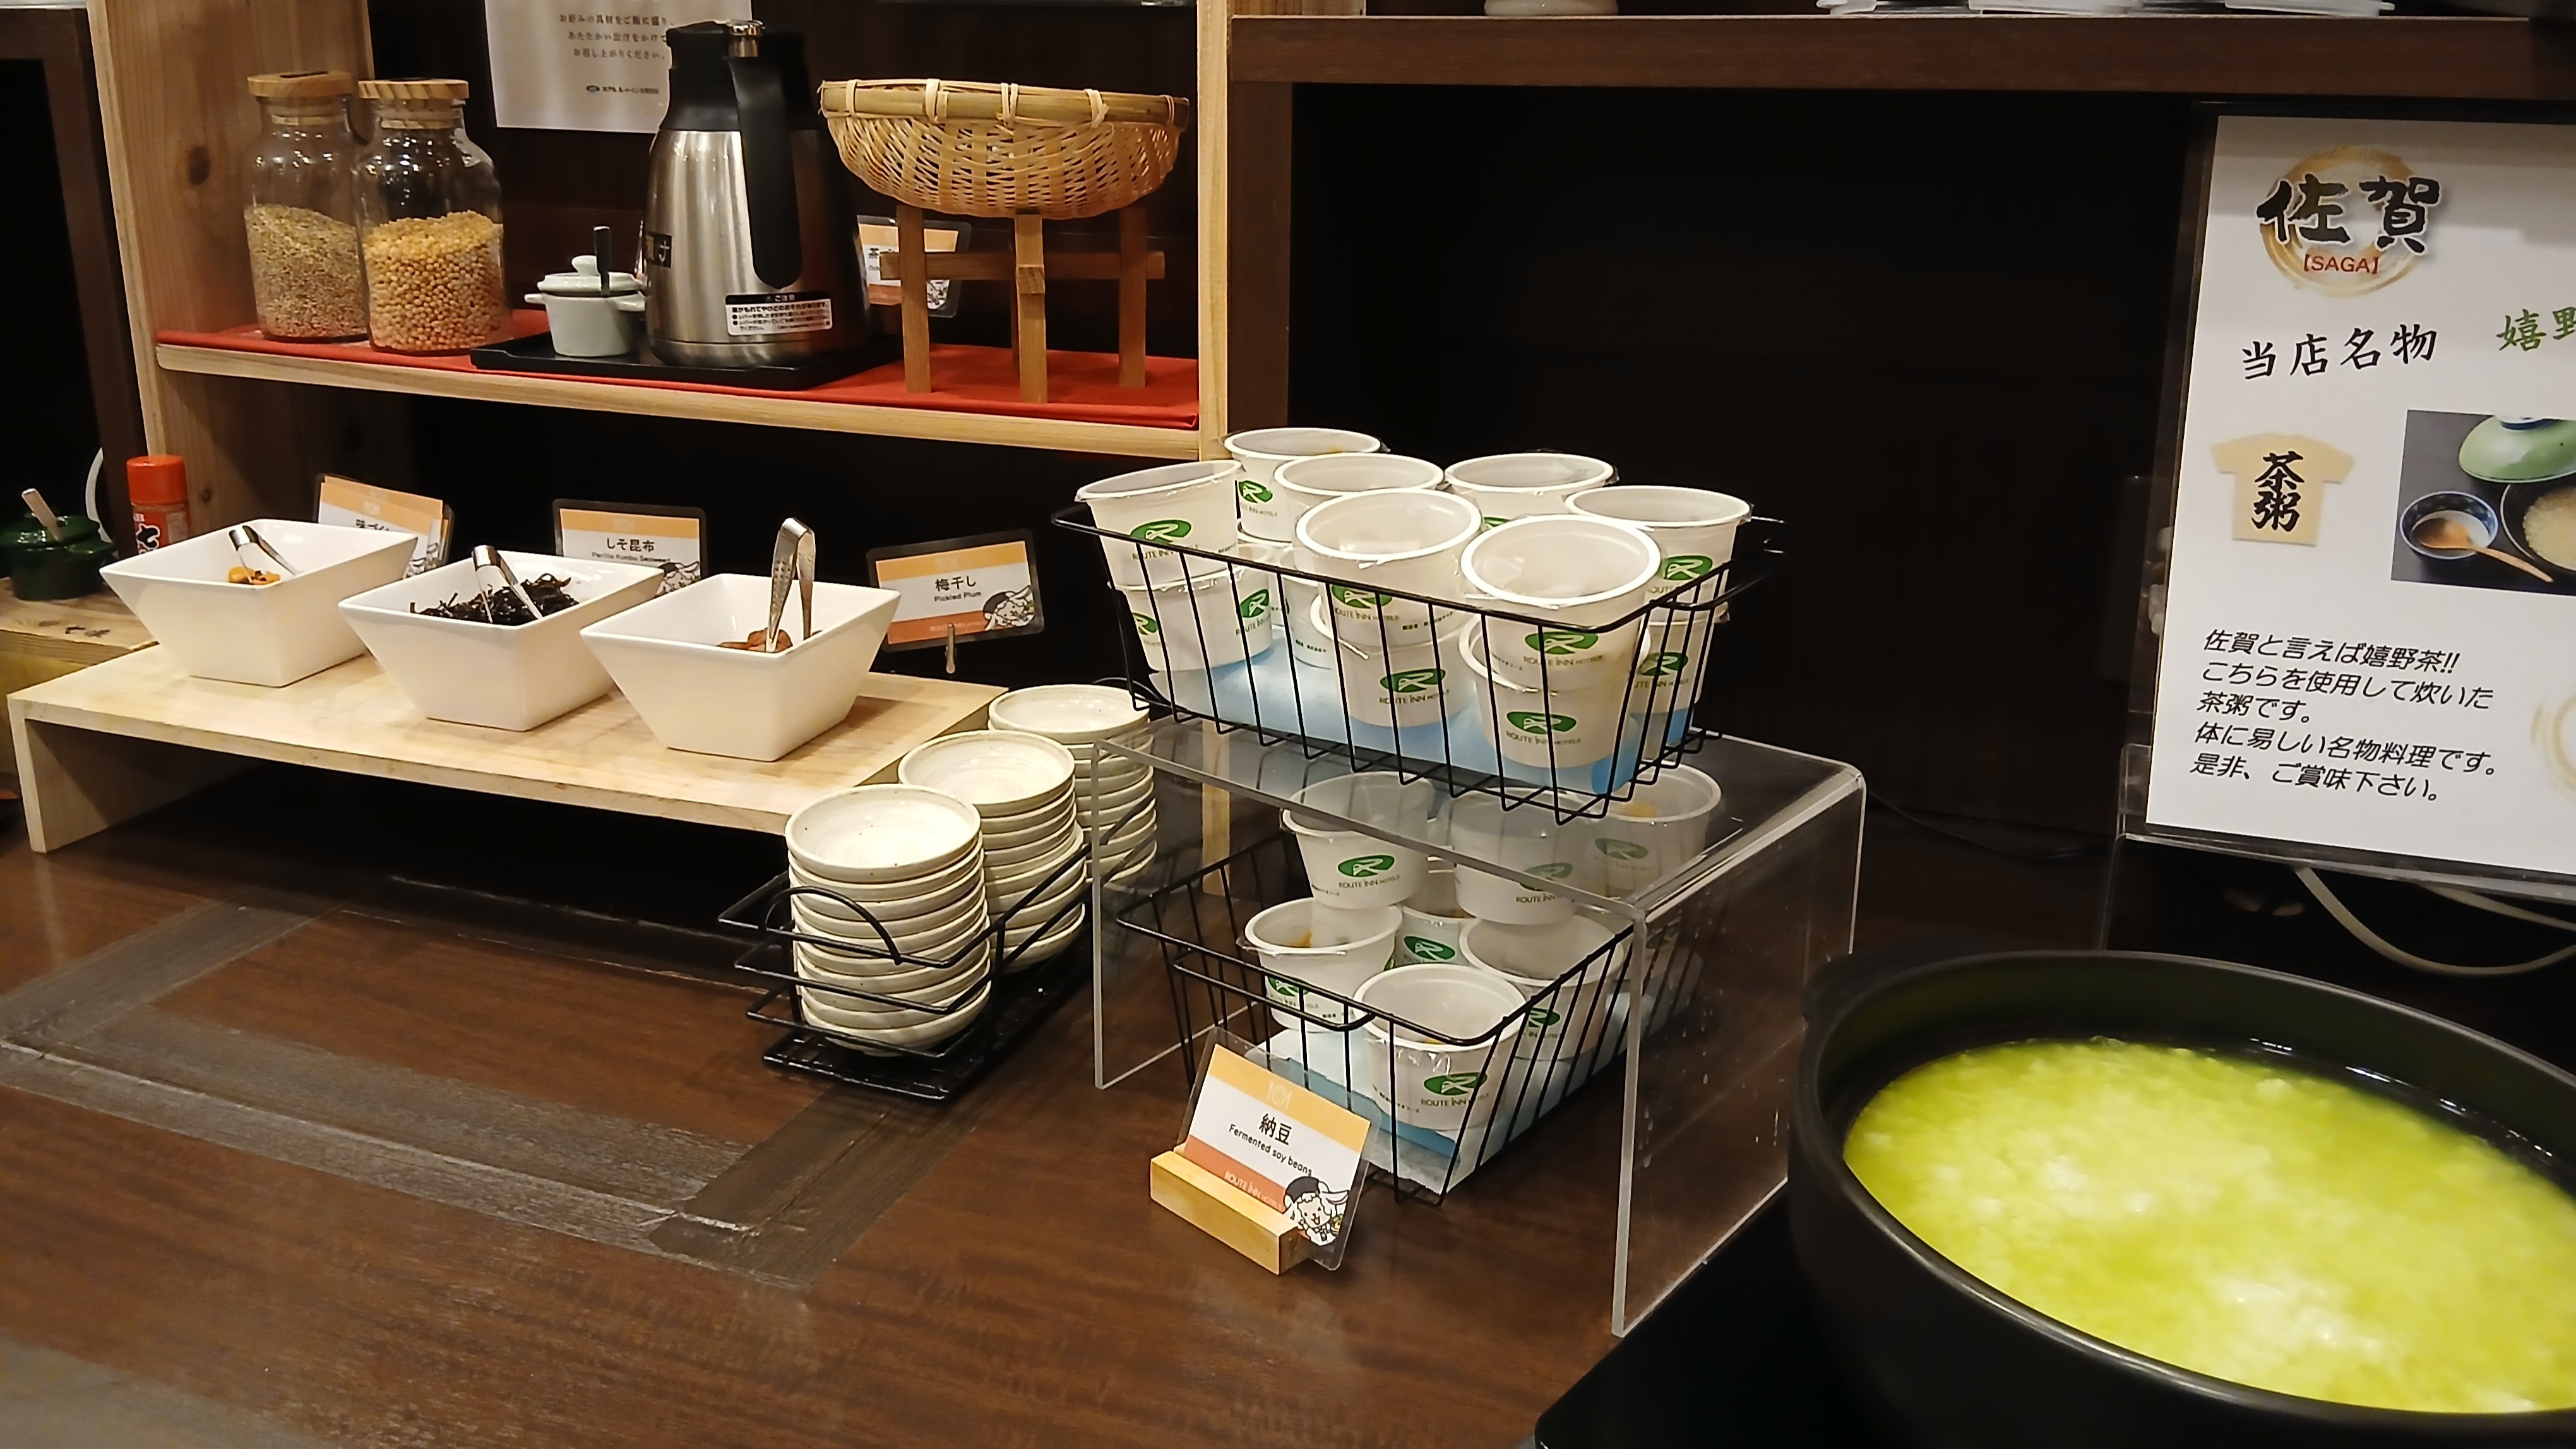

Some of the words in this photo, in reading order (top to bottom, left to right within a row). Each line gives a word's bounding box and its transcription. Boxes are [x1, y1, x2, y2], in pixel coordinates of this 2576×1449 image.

[2258, 174, 2440, 253] 佐賀
[2242, 325, 2437, 379] 当店名物
[2251, 451, 2305, 532] 茶粥
[607, 538, 655, 552] しそ昆布
[934, 593, 962, 602] Pickled
[935, 576, 977, 592] 梅干し
[2197, 691, 2310, 724] 茶粥です。
[2202, 662, 2494, 710] こちらを使用して炊いた
[2195, 722, 2495, 776] 体に易しい名物料理です。
[1229, 1124, 1272, 1153] Fermented
[1272, 1150, 1287, 1163] soy
[1288, 1156, 1312, 1176] beans
[1259, 1113, 1292, 1145] 納豆
